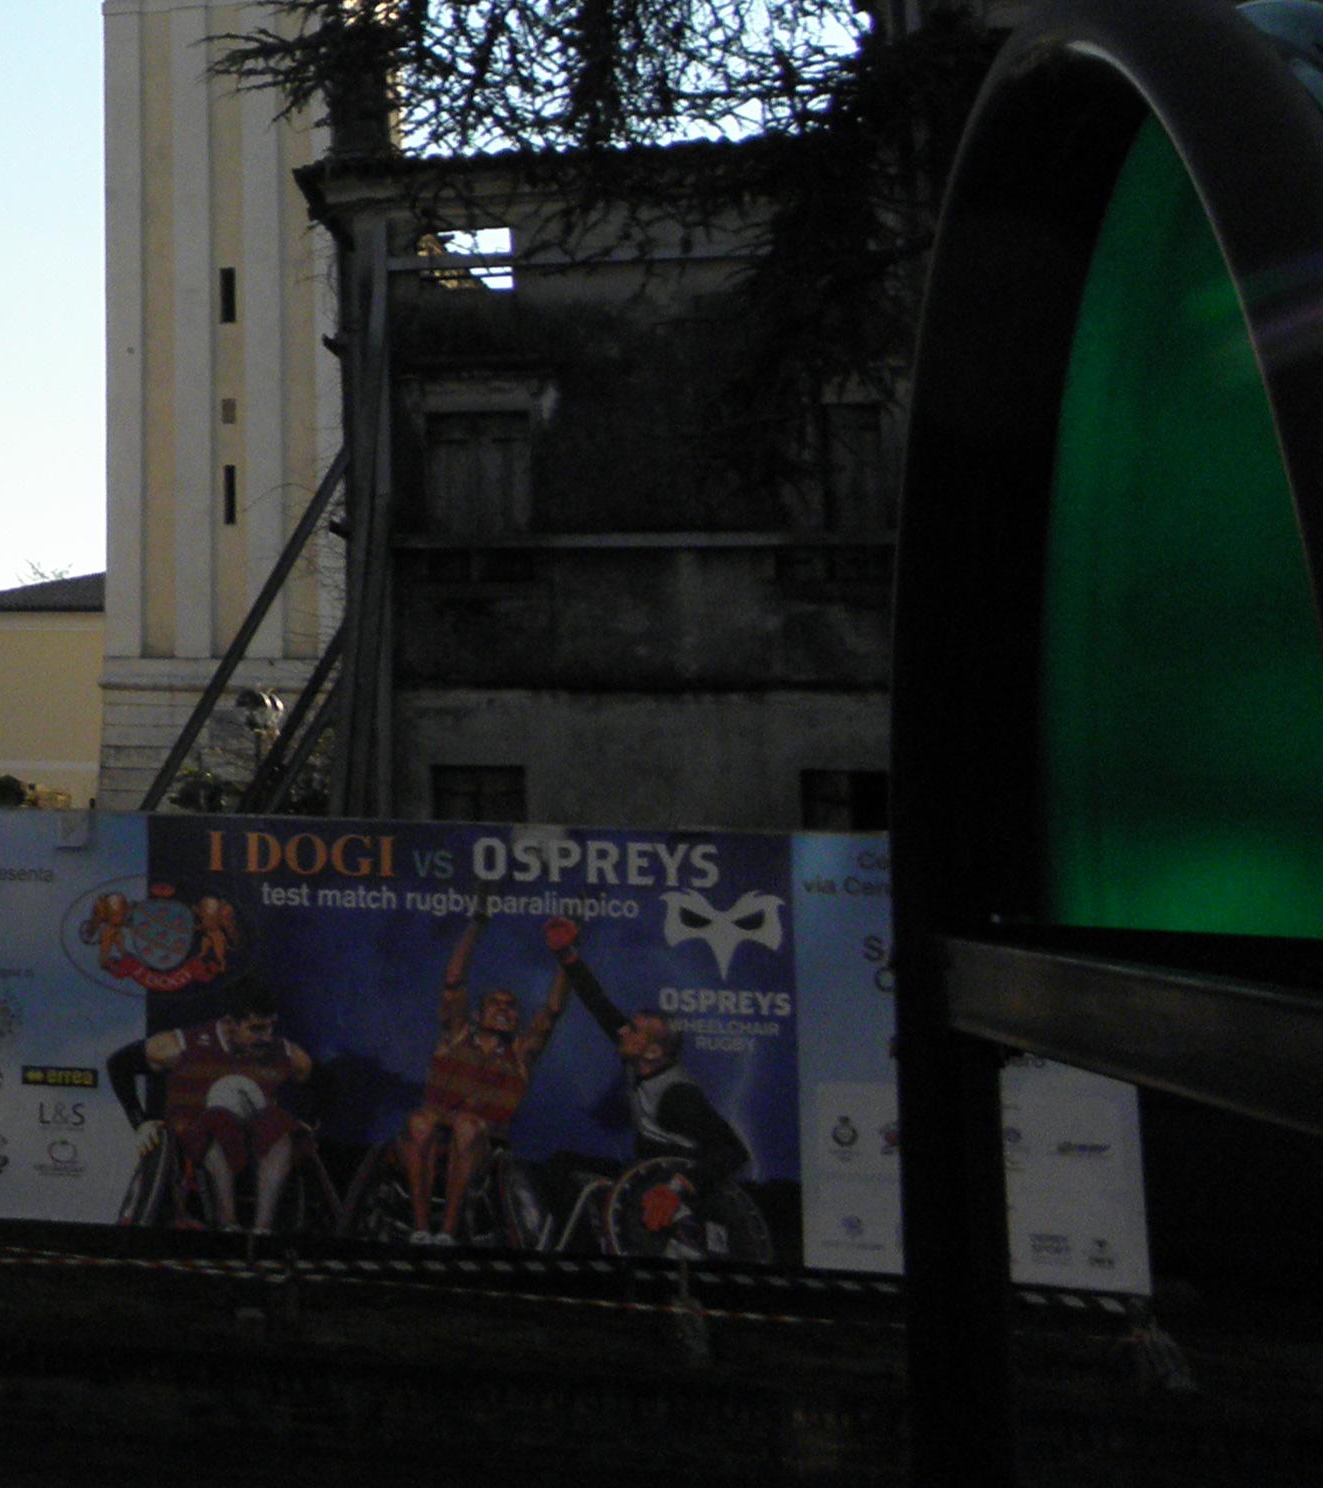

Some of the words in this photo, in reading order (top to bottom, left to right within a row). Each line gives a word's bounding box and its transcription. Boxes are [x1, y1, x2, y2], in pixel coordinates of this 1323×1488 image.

[208, 830, 225, 873] I
[244, 831, 396, 879] DOGI
[471, 836, 721, 889] OSPREYS
[261, 882, 311, 907] test
[316, 884, 398, 910] match
[405, 888, 480, 918] rugby
[485, 890, 640, 922] paralimpico
[658, 987, 792, 1017] OSPREYS
[667, 1017, 781, 1036] WHEELCHAIR
[695, 1035, 759, 1052] RUGBY
[38, 1101, 86, 1126] L&S
